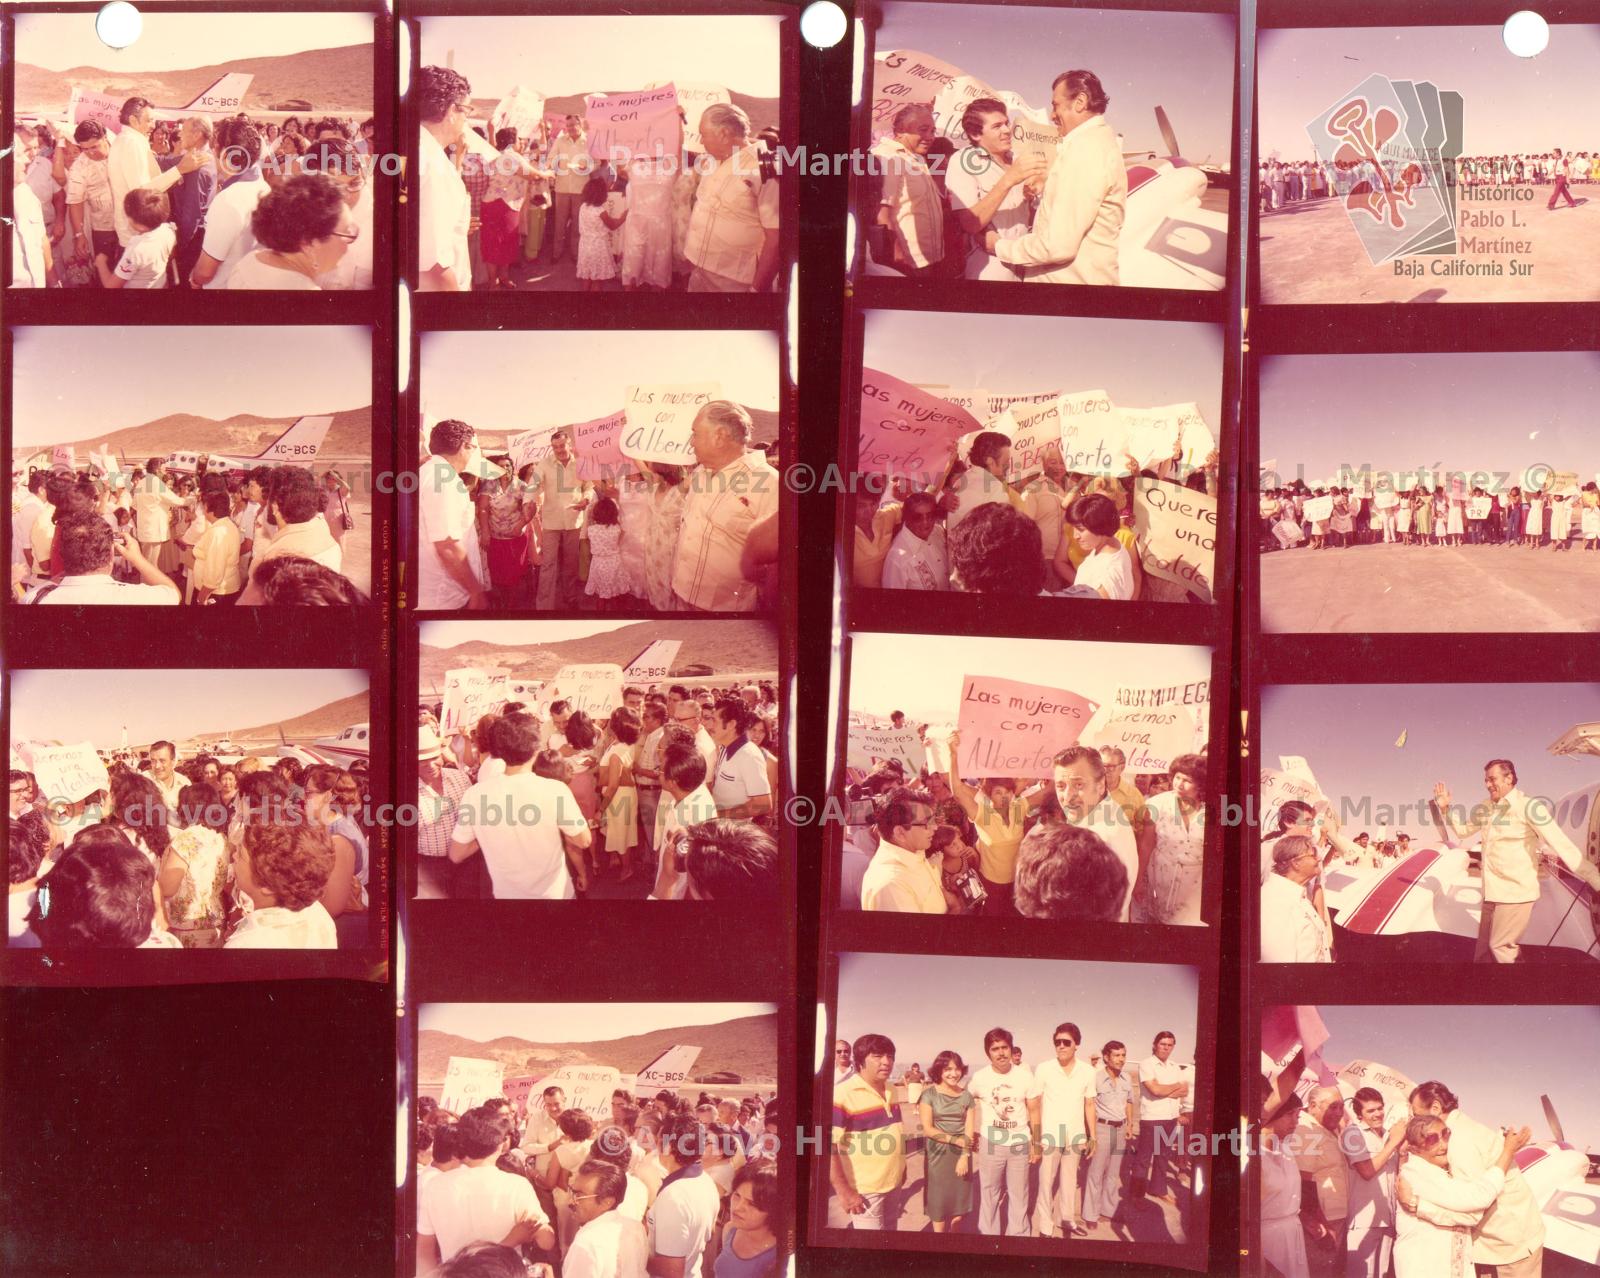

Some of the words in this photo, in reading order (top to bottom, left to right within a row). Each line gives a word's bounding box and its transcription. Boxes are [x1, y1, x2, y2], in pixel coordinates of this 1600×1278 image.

[882, 83, 912, 97] con
[201, 97, 239, 107] XC-BCS
[591, 100, 613, 109] Las
[618, 90, 675, 108] mujeres
[610, 112, 638, 122] con
[862, 383, 890, 403] as
[897, 399, 967, 430] mujeres
[879, 418, 928, 436] con
[274, 444, 317, 455] XC-BCS
[592, 437, 611, 449] con
[1014, 436, 1035, 450] con
[858, 434, 924, 468] lberto
[1064, 439, 1112, 467] berto
[1146, 488, 1217, 526] Quere
[1175, 528, 1215, 552] una
[628, 667, 667, 677] XC-BCS
[965, 682, 1001, 706] Las
[1009, 697, 1083, 720] mujeres
[1000, 720, 1043, 734] con
[864, 735, 913, 745] mujeres
[1121, 732, 1152, 746] una
[862, 745, 887, 753] con
[892, 745, 905, 754] el
[966, 737, 1054, 770] Alberto
[1128, 747, 1168, 770] ldesa
[1345, 1061, 1367, 1077] Las
[645, 1071, 685, 1082] XC-BCS
